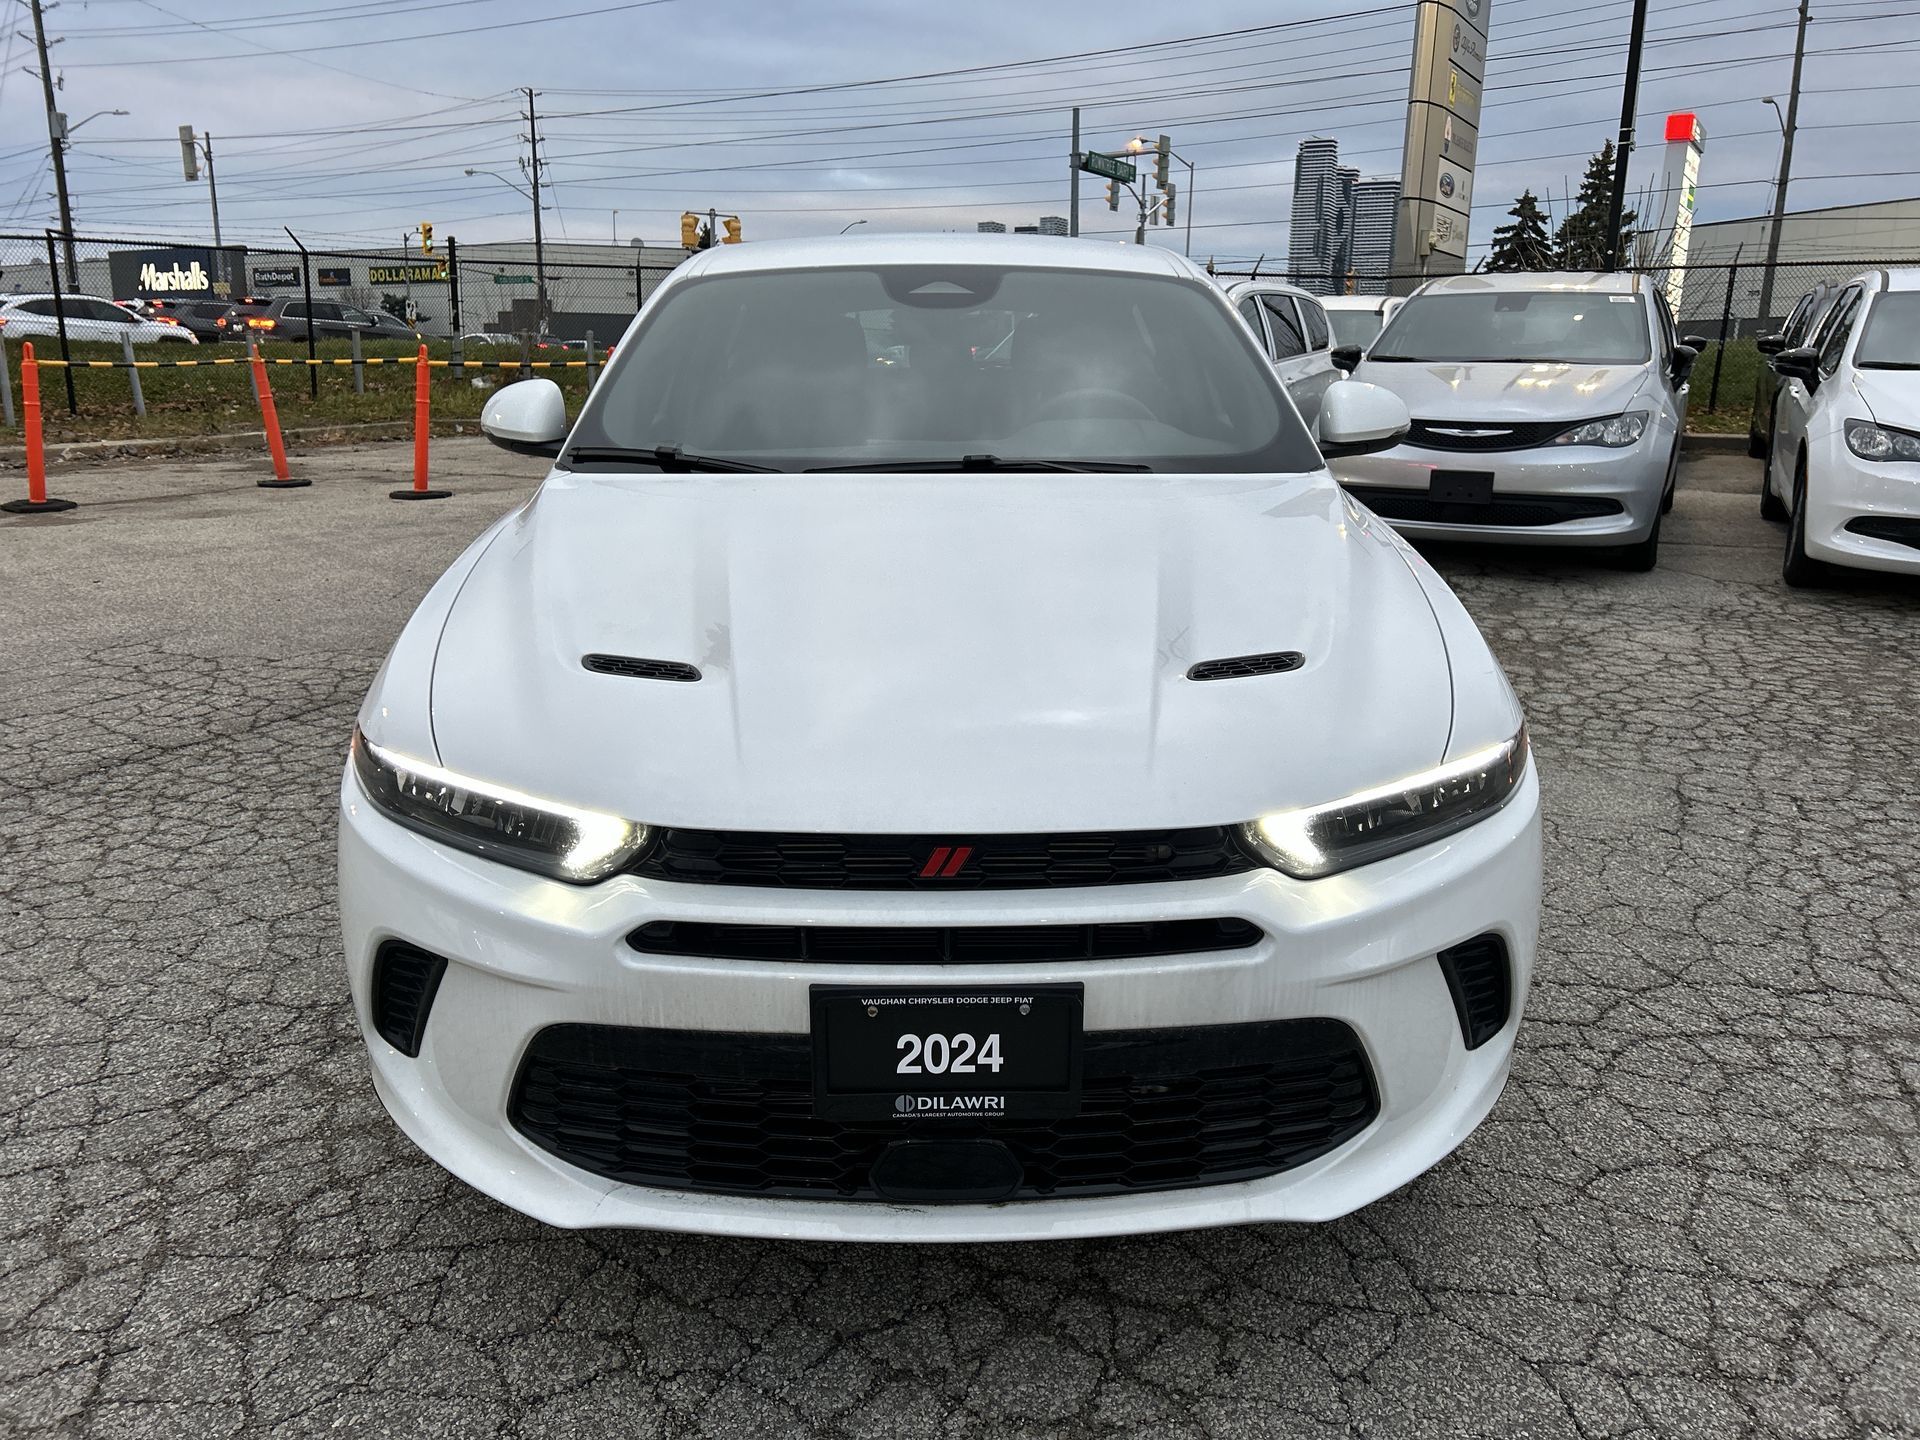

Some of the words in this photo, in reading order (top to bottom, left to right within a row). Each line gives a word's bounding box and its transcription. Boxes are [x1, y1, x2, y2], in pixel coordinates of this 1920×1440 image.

[138, 261, 209, 291] Marshalls
[861, 998, 906, 1006] VAUGHAN
[908, 997, 954, 1005] CHRYSLER
[956, 996, 989, 1004] DODGE
[990, 996, 1013, 1004] JEEP
[1014, 996, 1034, 1004] FIAT
[896, 1033, 1004, 1075] 2024
[917, 1096, 1005, 1110] DILAWRI
